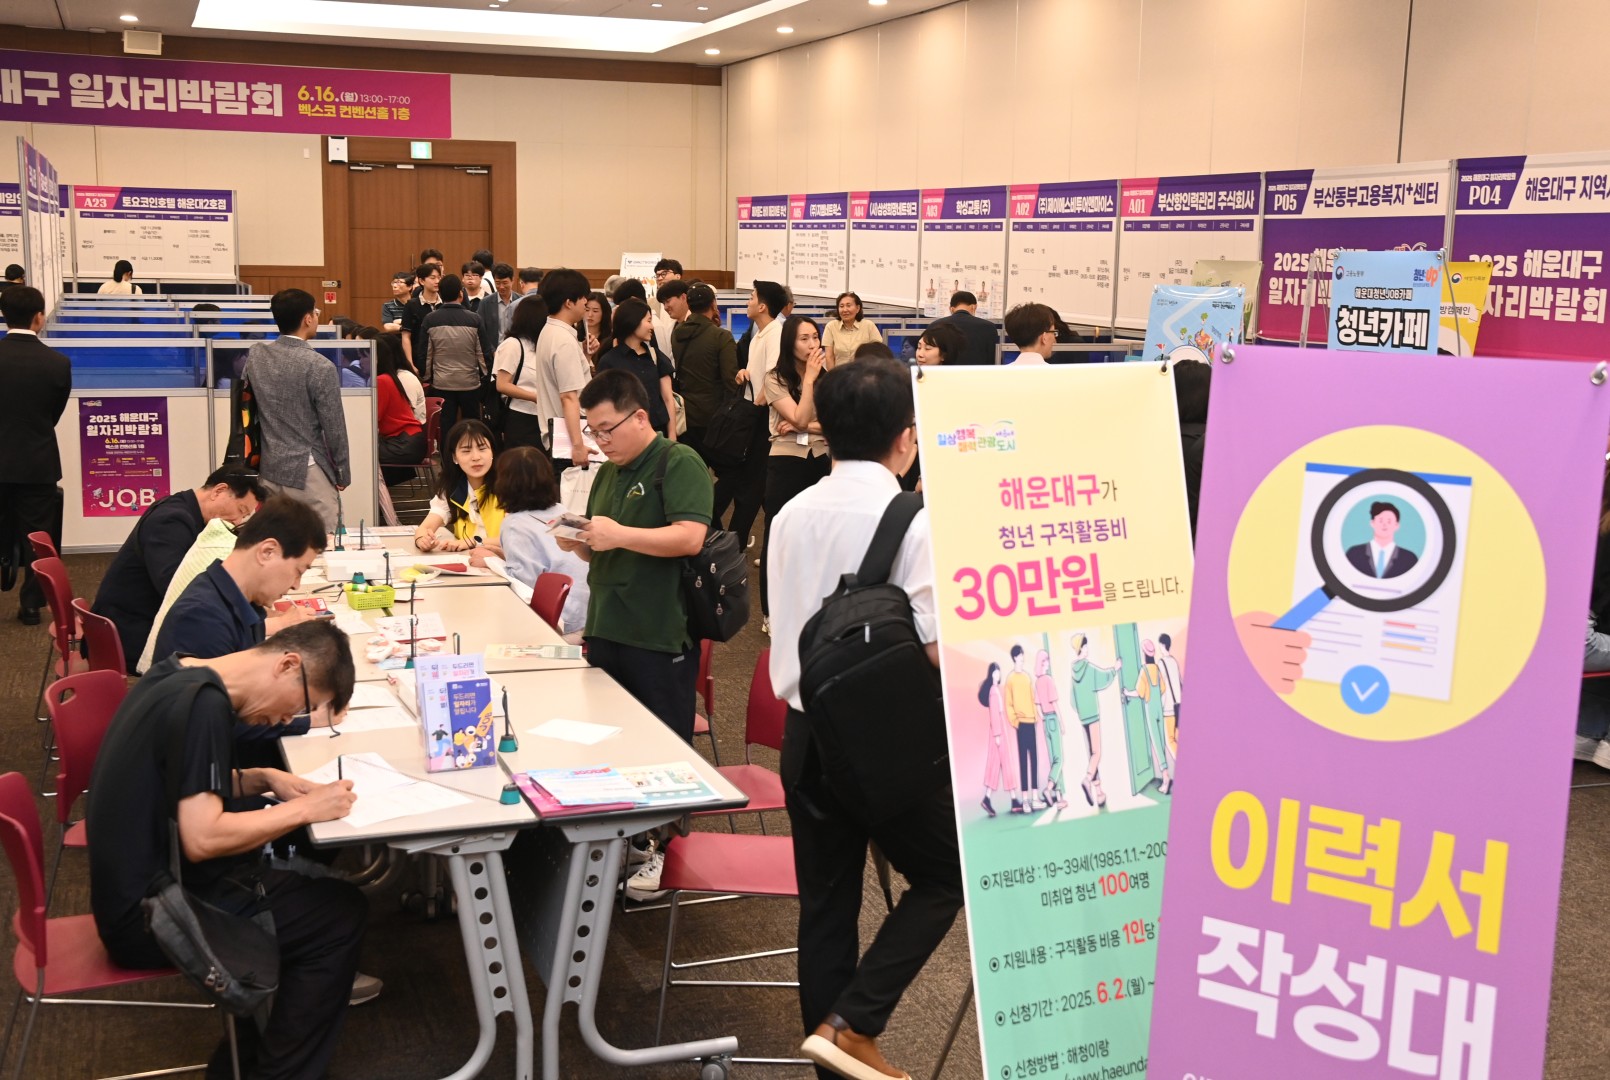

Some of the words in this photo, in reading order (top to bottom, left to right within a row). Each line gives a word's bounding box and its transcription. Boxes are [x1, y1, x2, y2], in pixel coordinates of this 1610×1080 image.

[69, 73, 283, 117] 일자리박람회
[297, 85, 358, 103] 6.16.(월)
[298, 104, 336, 117] 벡스코
[339, 105, 389, 120] 컨벤션홀
[391, 108, 411, 120] 1층
[1158, 191, 1217, 212] 부산항인력관리
[1217, 190, 1255, 211] 주식회사
[1468, 185, 1502, 206] P04
[1525, 176, 1577, 202] 해운대구
[84, 197, 107, 208] A23
[122, 196, 176, 209] 토요코인호텔
[177, 198, 227, 211] 해운대2호점
[1016, 202, 1030, 216] A02
[1128, 198, 1146, 214] A01
[1274, 194, 1297, 212] P05
[1274, 252, 1309, 272] 2025
[1523, 249, 1603, 280] 해운대구
[1355, 287, 1413, 301] 해운대청년JOB카페
[1482, 284, 1607, 324] 자리박람회
[1337, 305, 1430, 350] 청년카페
[86, 424, 163, 437] 일자리박람회
[89, 415, 117, 424] 2025
[119, 412, 158, 423] 해운대구
[99, 488, 156, 508] JOB
[998, 474, 1117, 511] 해운대구가
[999, 524, 1035, 550] 청년
[1040, 517, 1128, 546] 구직활동비
[952, 552, 1117, 621] 30만원을
[1122, 576, 1184, 600] 드립니다.
[991, 865, 1035, 890] 지원대상
[1210, 790, 1509, 955] 이력서
[1041, 886, 1073, 907] 미취업
[1075, 882, 1097, 902] 청년
[1098, 870, 1150, 897] 100여명
[1003, 945, 1047, 970] 지원내용
[1055, 935, 1097, 960] 구직활동
[1099, 929, 1121, 949] 비용
[1122, 918, 1155, 945] 1인당
[1196, 915, 1498, 1080] 작성대
[1009, 1000, 1053, 1025] 신청기간
[1015, 1052, 1059, 1079] 신청방법
[1067, 1038, 1110, 1065] 해청이랑
